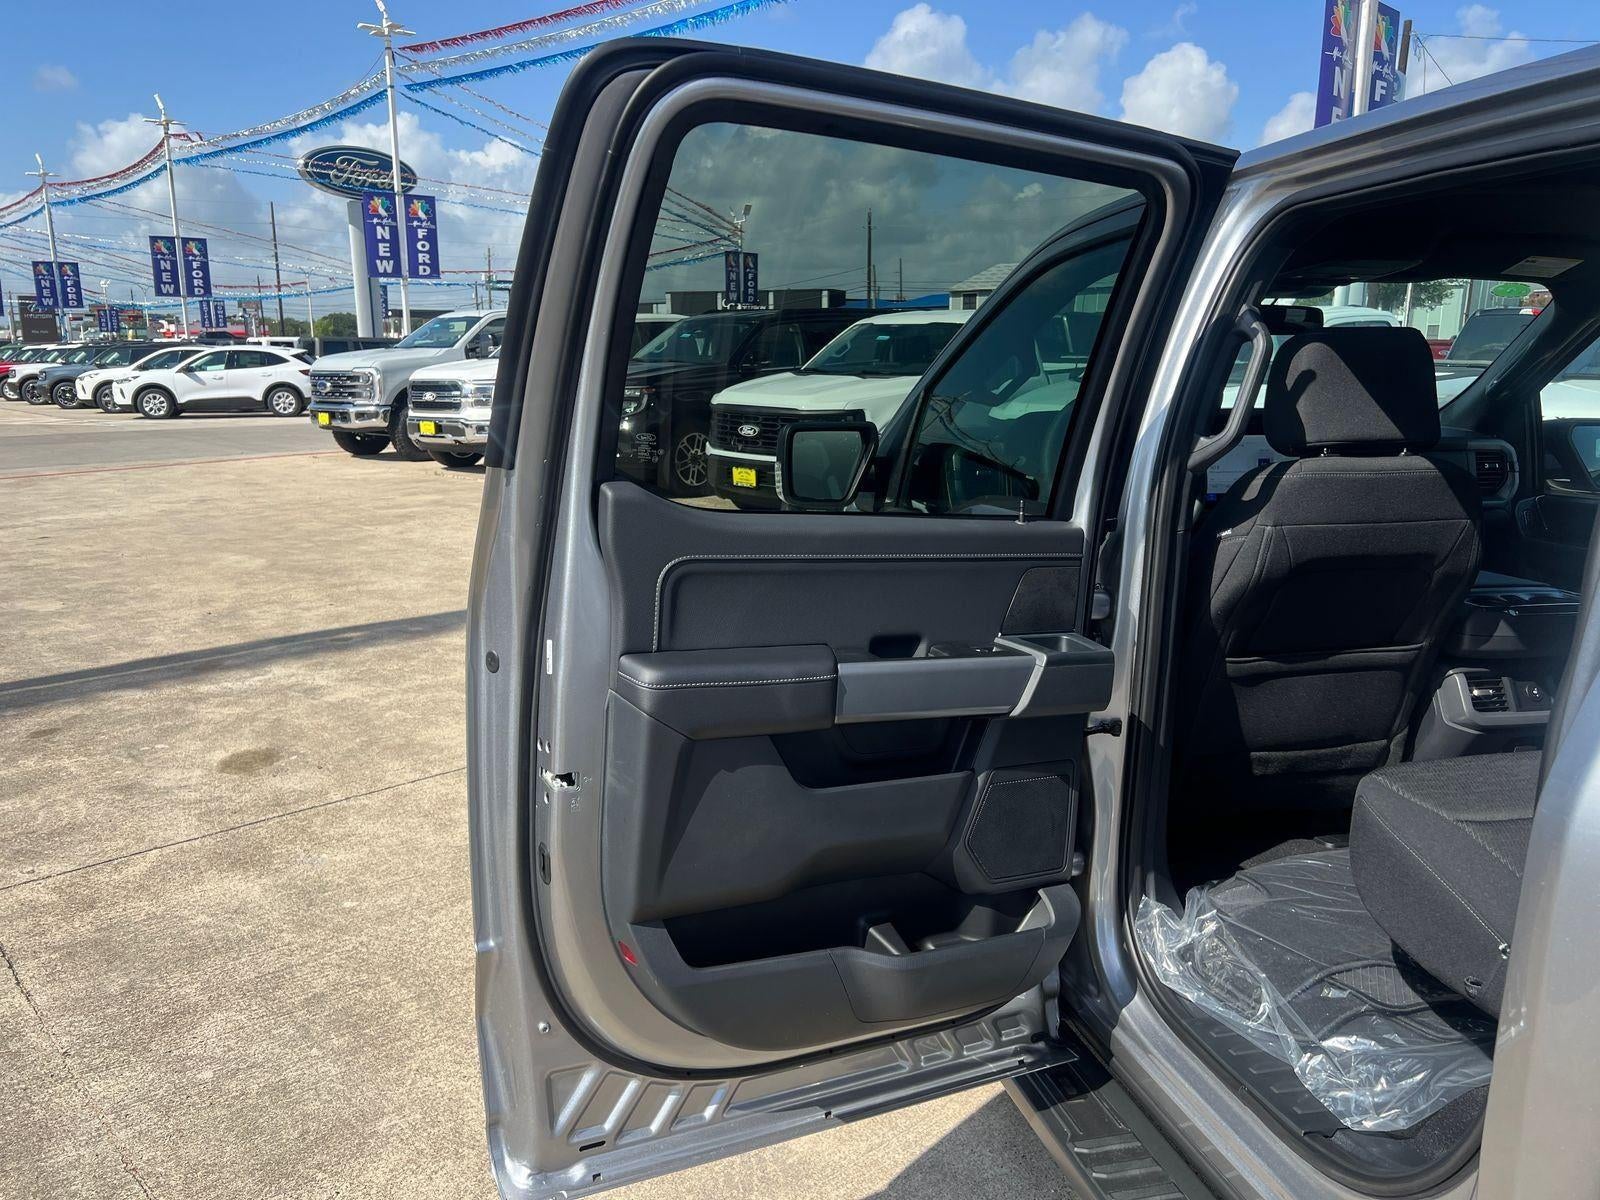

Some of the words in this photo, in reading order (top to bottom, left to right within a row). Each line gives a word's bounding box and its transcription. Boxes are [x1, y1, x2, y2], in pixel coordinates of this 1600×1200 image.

[330, 155, 397, 188] Ford
[376, 226, 394, 274] NEW
[416, 228, 431, 276] FORD
[40, 279, 54, 306] NEW
[66, 280, 78, 307] FORD
[160, 260, 174, 294] NEW
[192, 261, 205, 295] FORD
[729, 272, 738, 301] NEW
[747, 273, 755, 302] FORD
